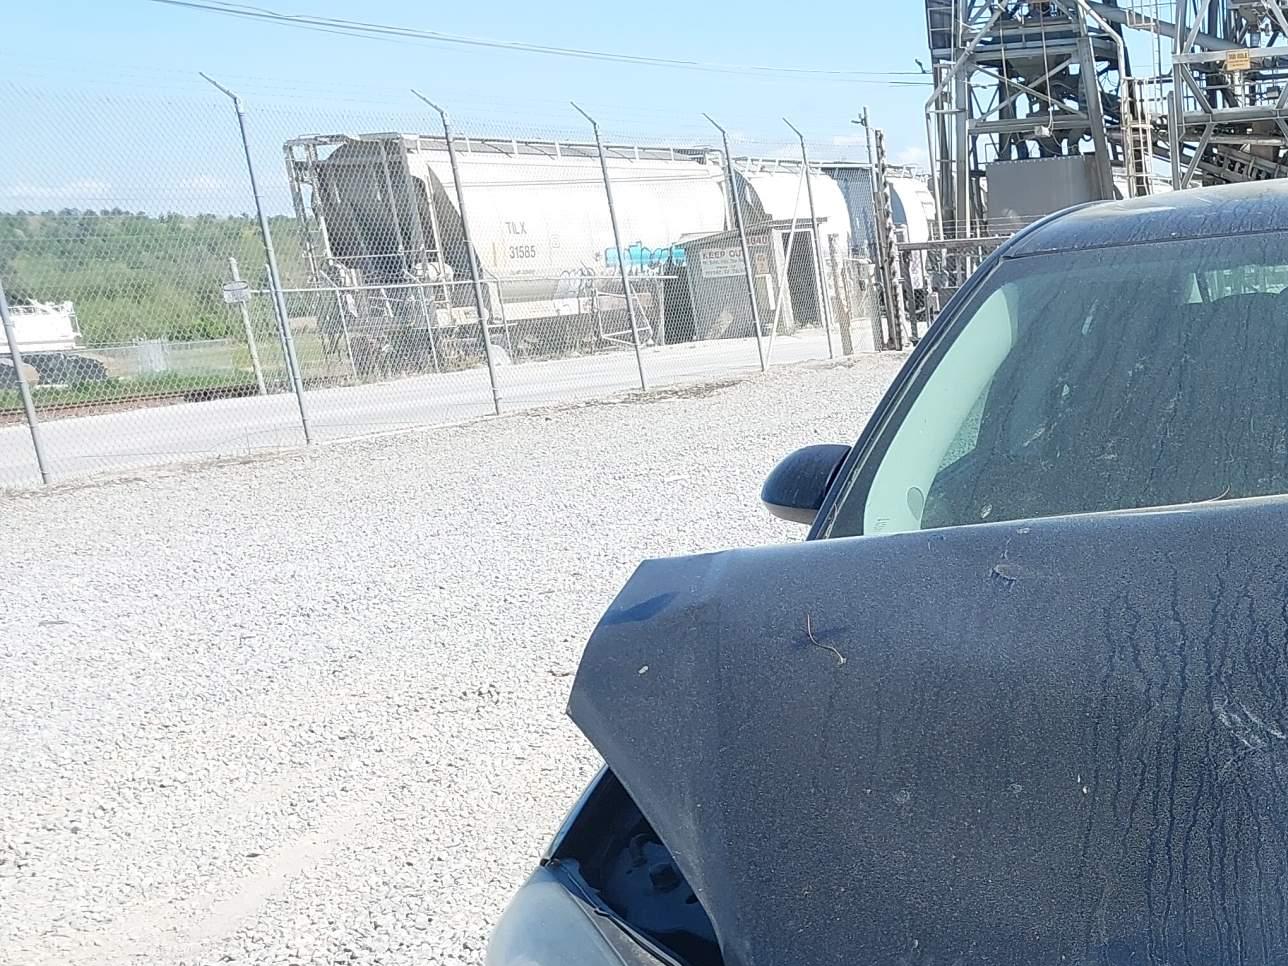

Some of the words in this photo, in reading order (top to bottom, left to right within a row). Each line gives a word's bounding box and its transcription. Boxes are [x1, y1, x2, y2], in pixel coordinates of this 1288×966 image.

[505, 221, 527, 235] TILX
[703, 250, 726, 260] KEEP
[729, 249, 744, 258] OU
